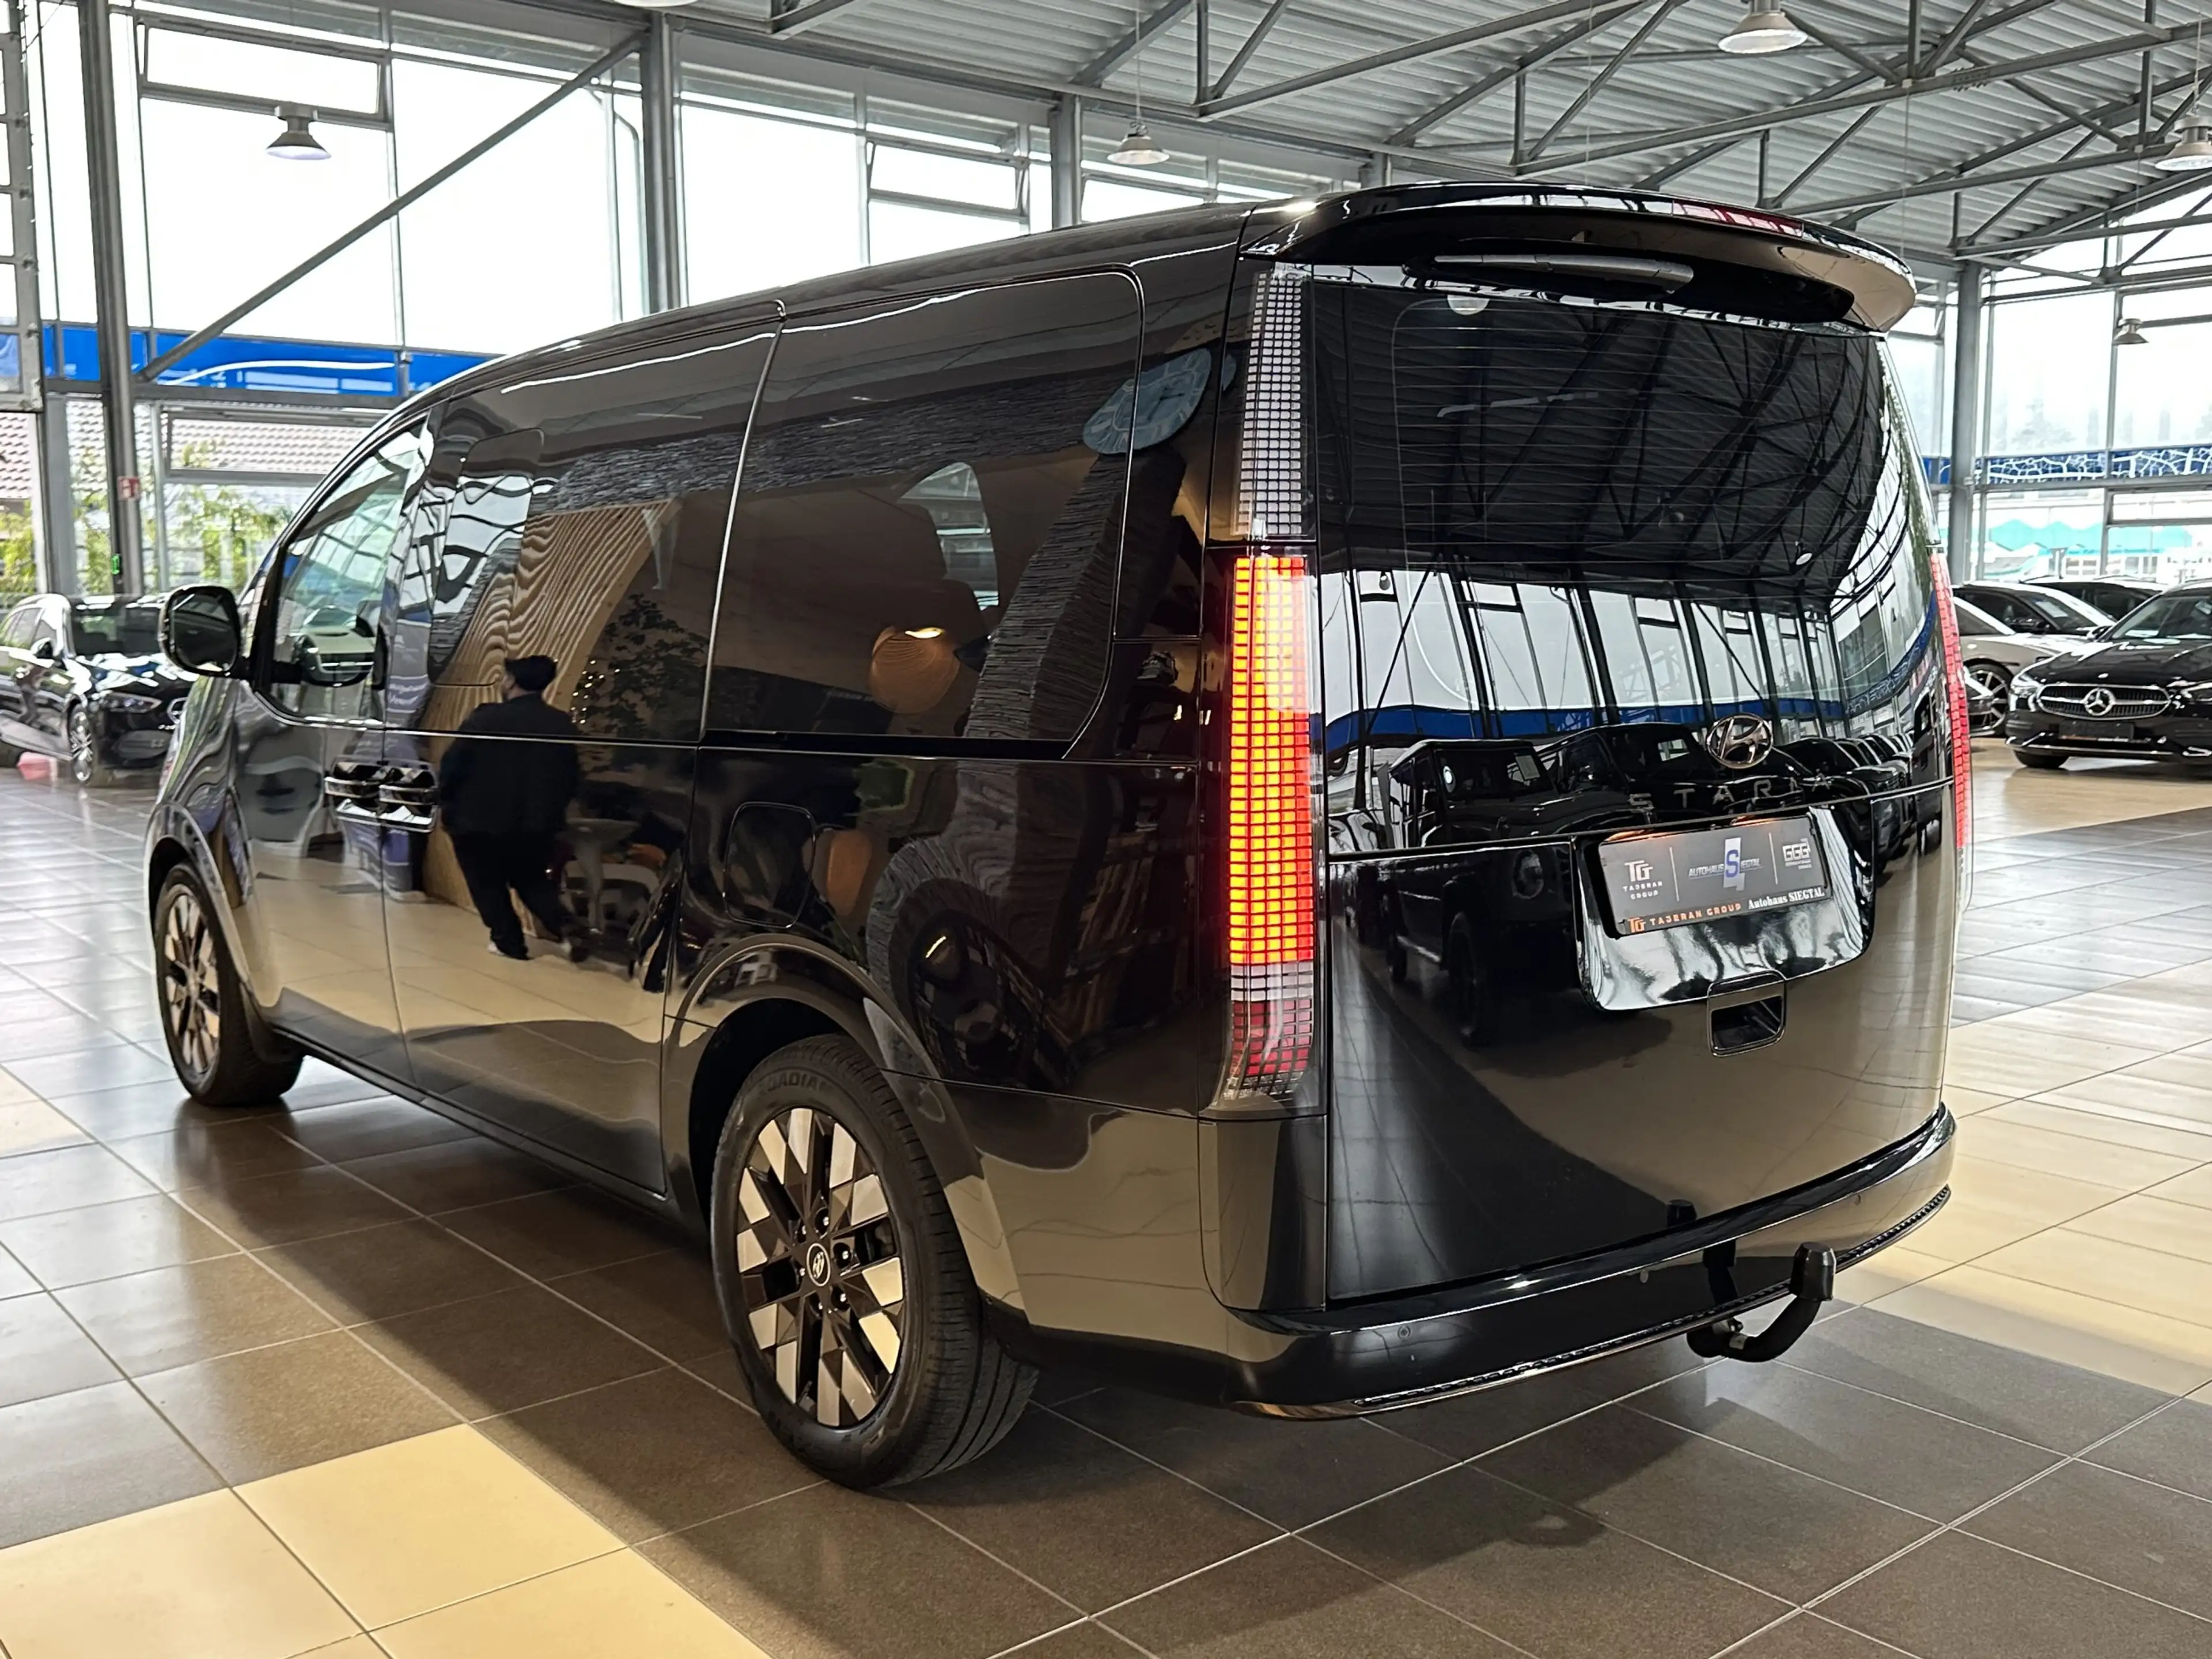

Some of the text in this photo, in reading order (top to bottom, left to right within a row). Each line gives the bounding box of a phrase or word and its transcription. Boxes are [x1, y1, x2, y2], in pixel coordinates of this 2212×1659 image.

[1688, 863, 1724, 877] AUTOHAUS
[1623, 881, 1663, 892] TAJERAN
[1630, 890, 1658, 900] GROUP
[1748, 887, 1825, 909] Autohaus SIEGTAL
[1650, 910, 1702, 926] TAJERAN
[1706, 903, 1741, 916] GROUP
